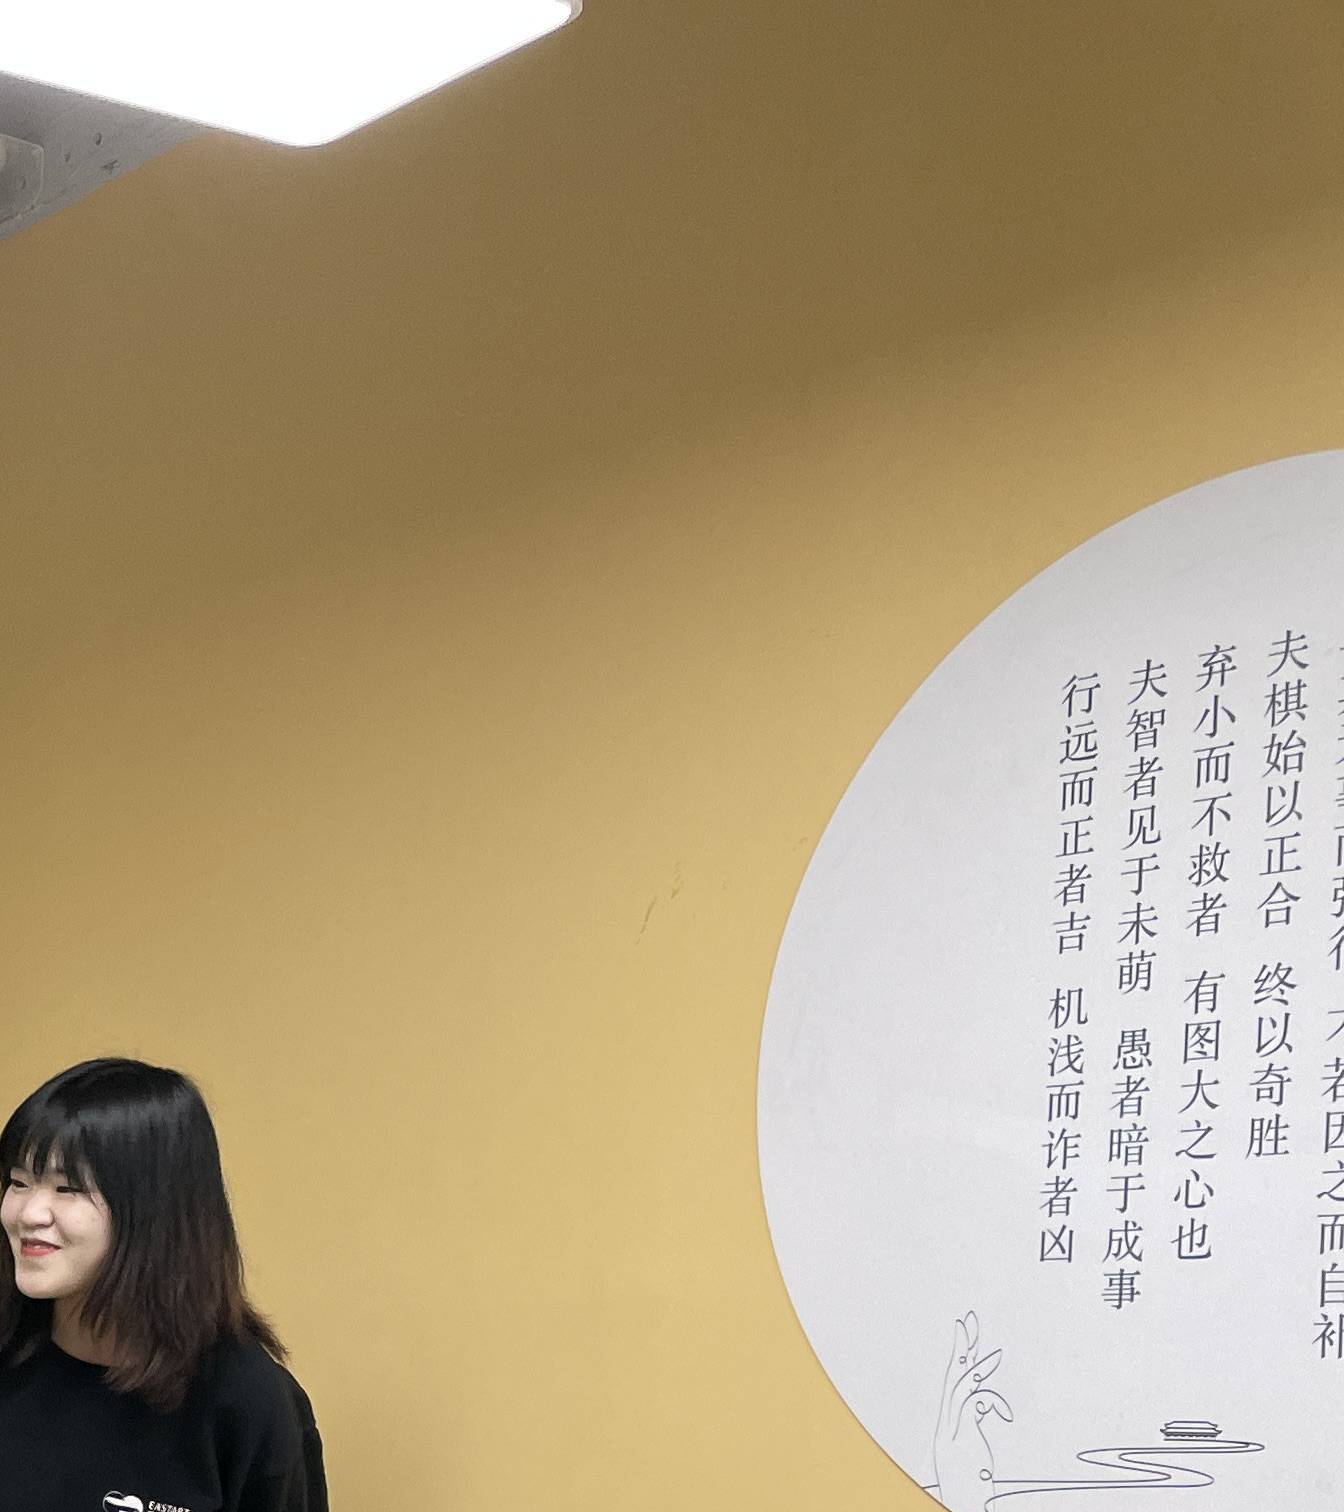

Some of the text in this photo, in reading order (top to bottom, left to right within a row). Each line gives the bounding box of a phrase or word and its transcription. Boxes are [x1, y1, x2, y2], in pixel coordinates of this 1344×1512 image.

[1039, 673, 1101, 1263] 行远而正者吉 机浅而诈者凶
[1101, 659, 1168, 1310] 夫智者见于未萌 愚者暗于成事
[1171, 644, 1237, 1261] 弃小而不救者 有图大之心也
[1245, 630, 1310, 1160] 夫棋始以正合 终以奇胜
